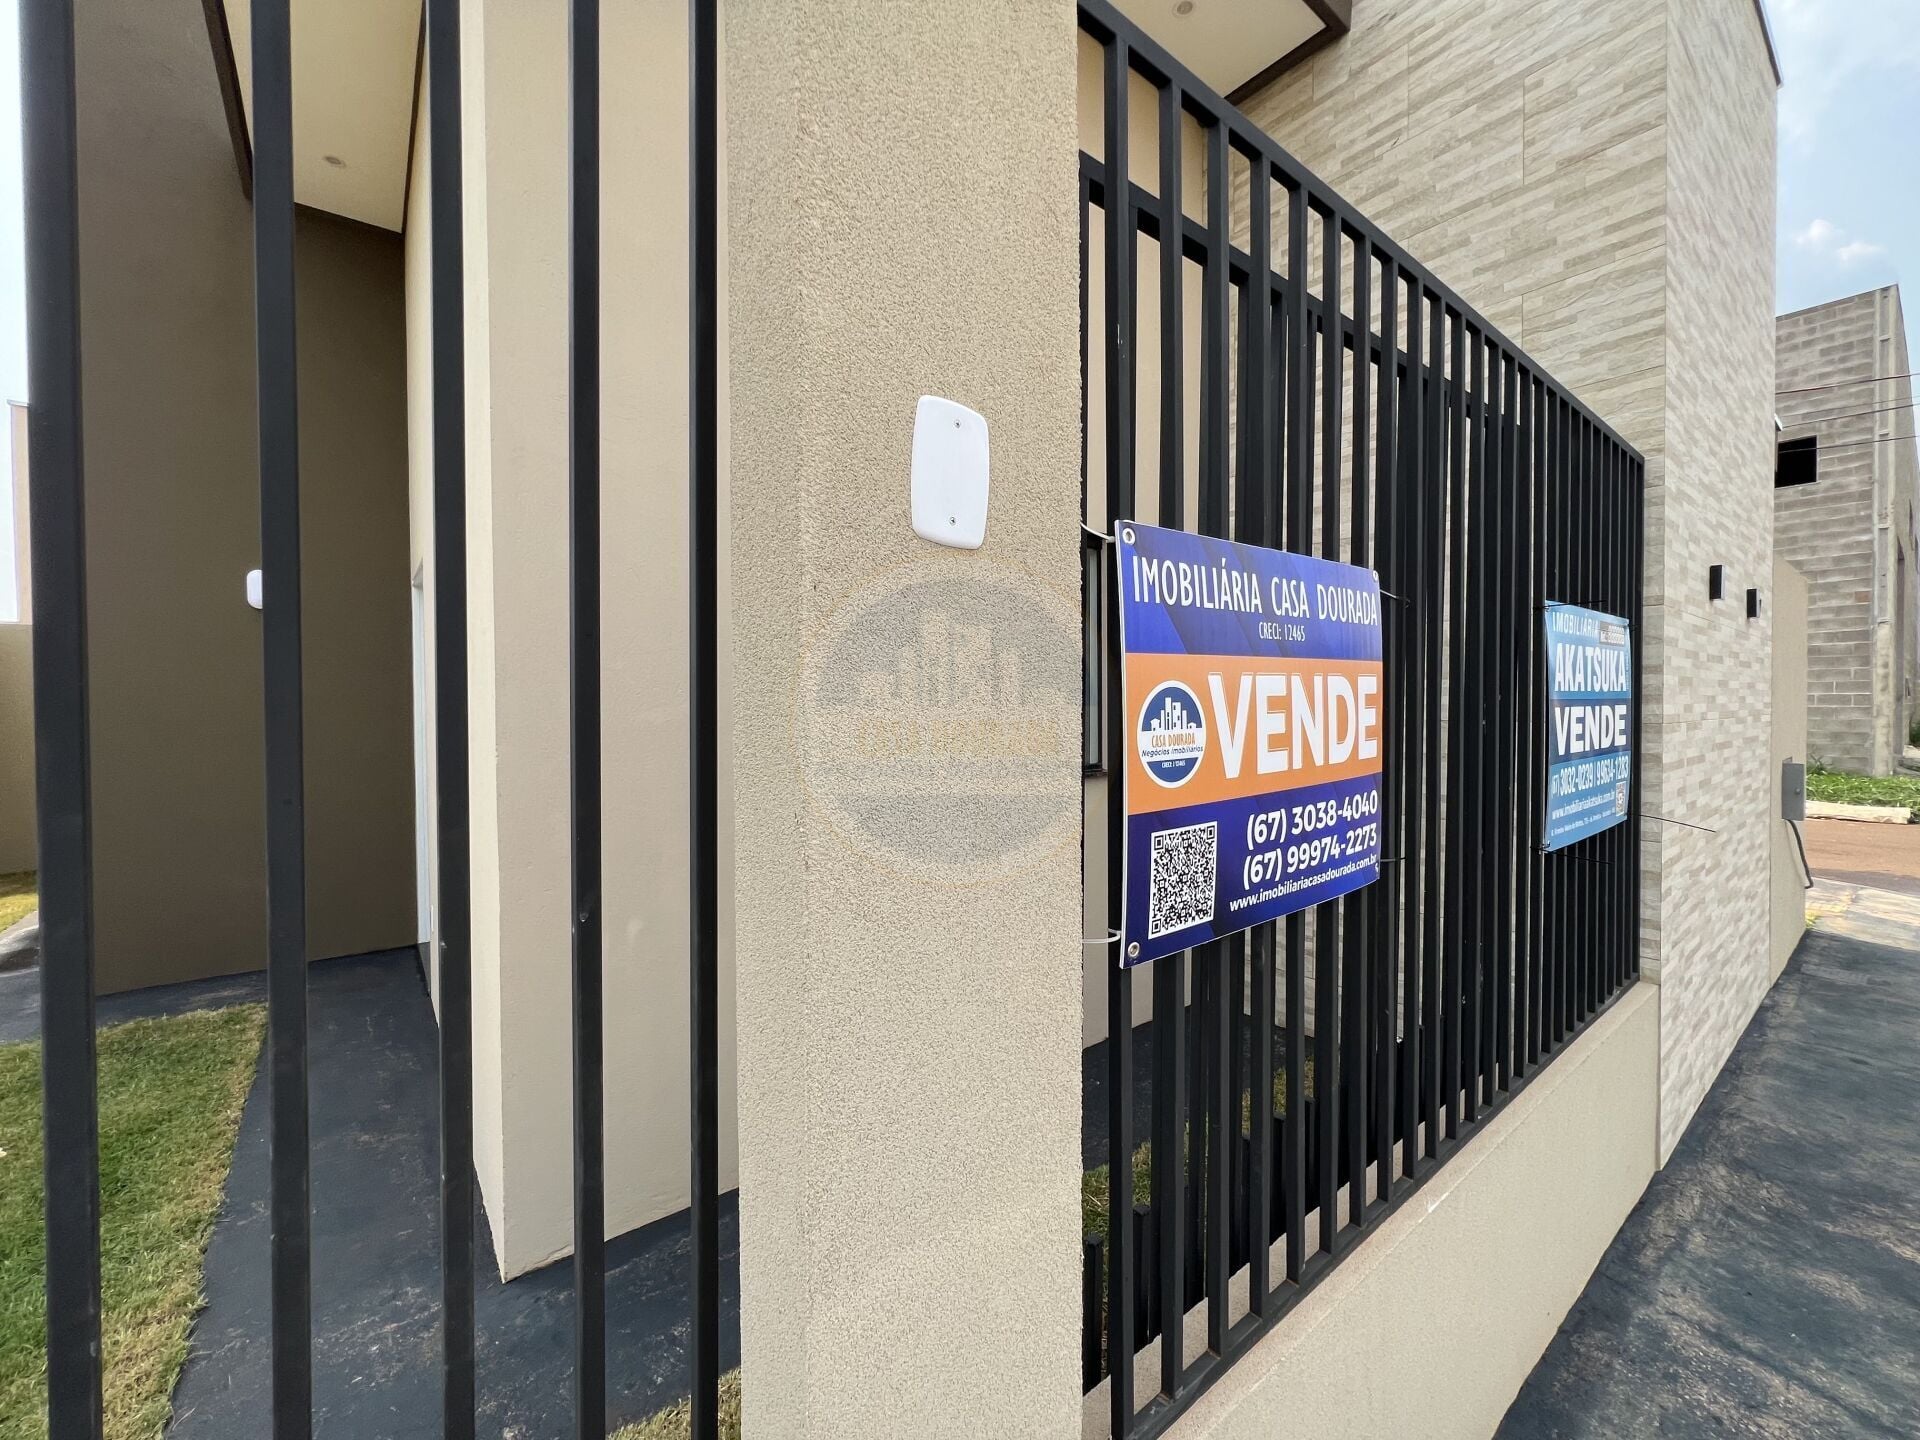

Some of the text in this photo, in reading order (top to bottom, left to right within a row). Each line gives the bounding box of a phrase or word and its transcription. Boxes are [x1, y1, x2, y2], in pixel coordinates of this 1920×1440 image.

[1132, 556, 1378, 626] IMOBILIÁRIA CASA DOURADA
[1258, 621, 1306, 642] CRECI: 12465
[1552, 612, 1600, 639] IMOBILIÁRIA
[1554, 642, 1627, 693] AKATSUKA
[1151, 732, 1196, 748] CASA DOURADA
[1207, 671, 1378, 780] VENDE
[1554, 704, 1627, 756] VENDE
[1246, 789, 1378, 851] (67) 3038-4040
[1229, 853, 1377, 912] www.imobiliariacasadourada.com.br
[1243, 822, 1378, 891] (67) 99974-2273
